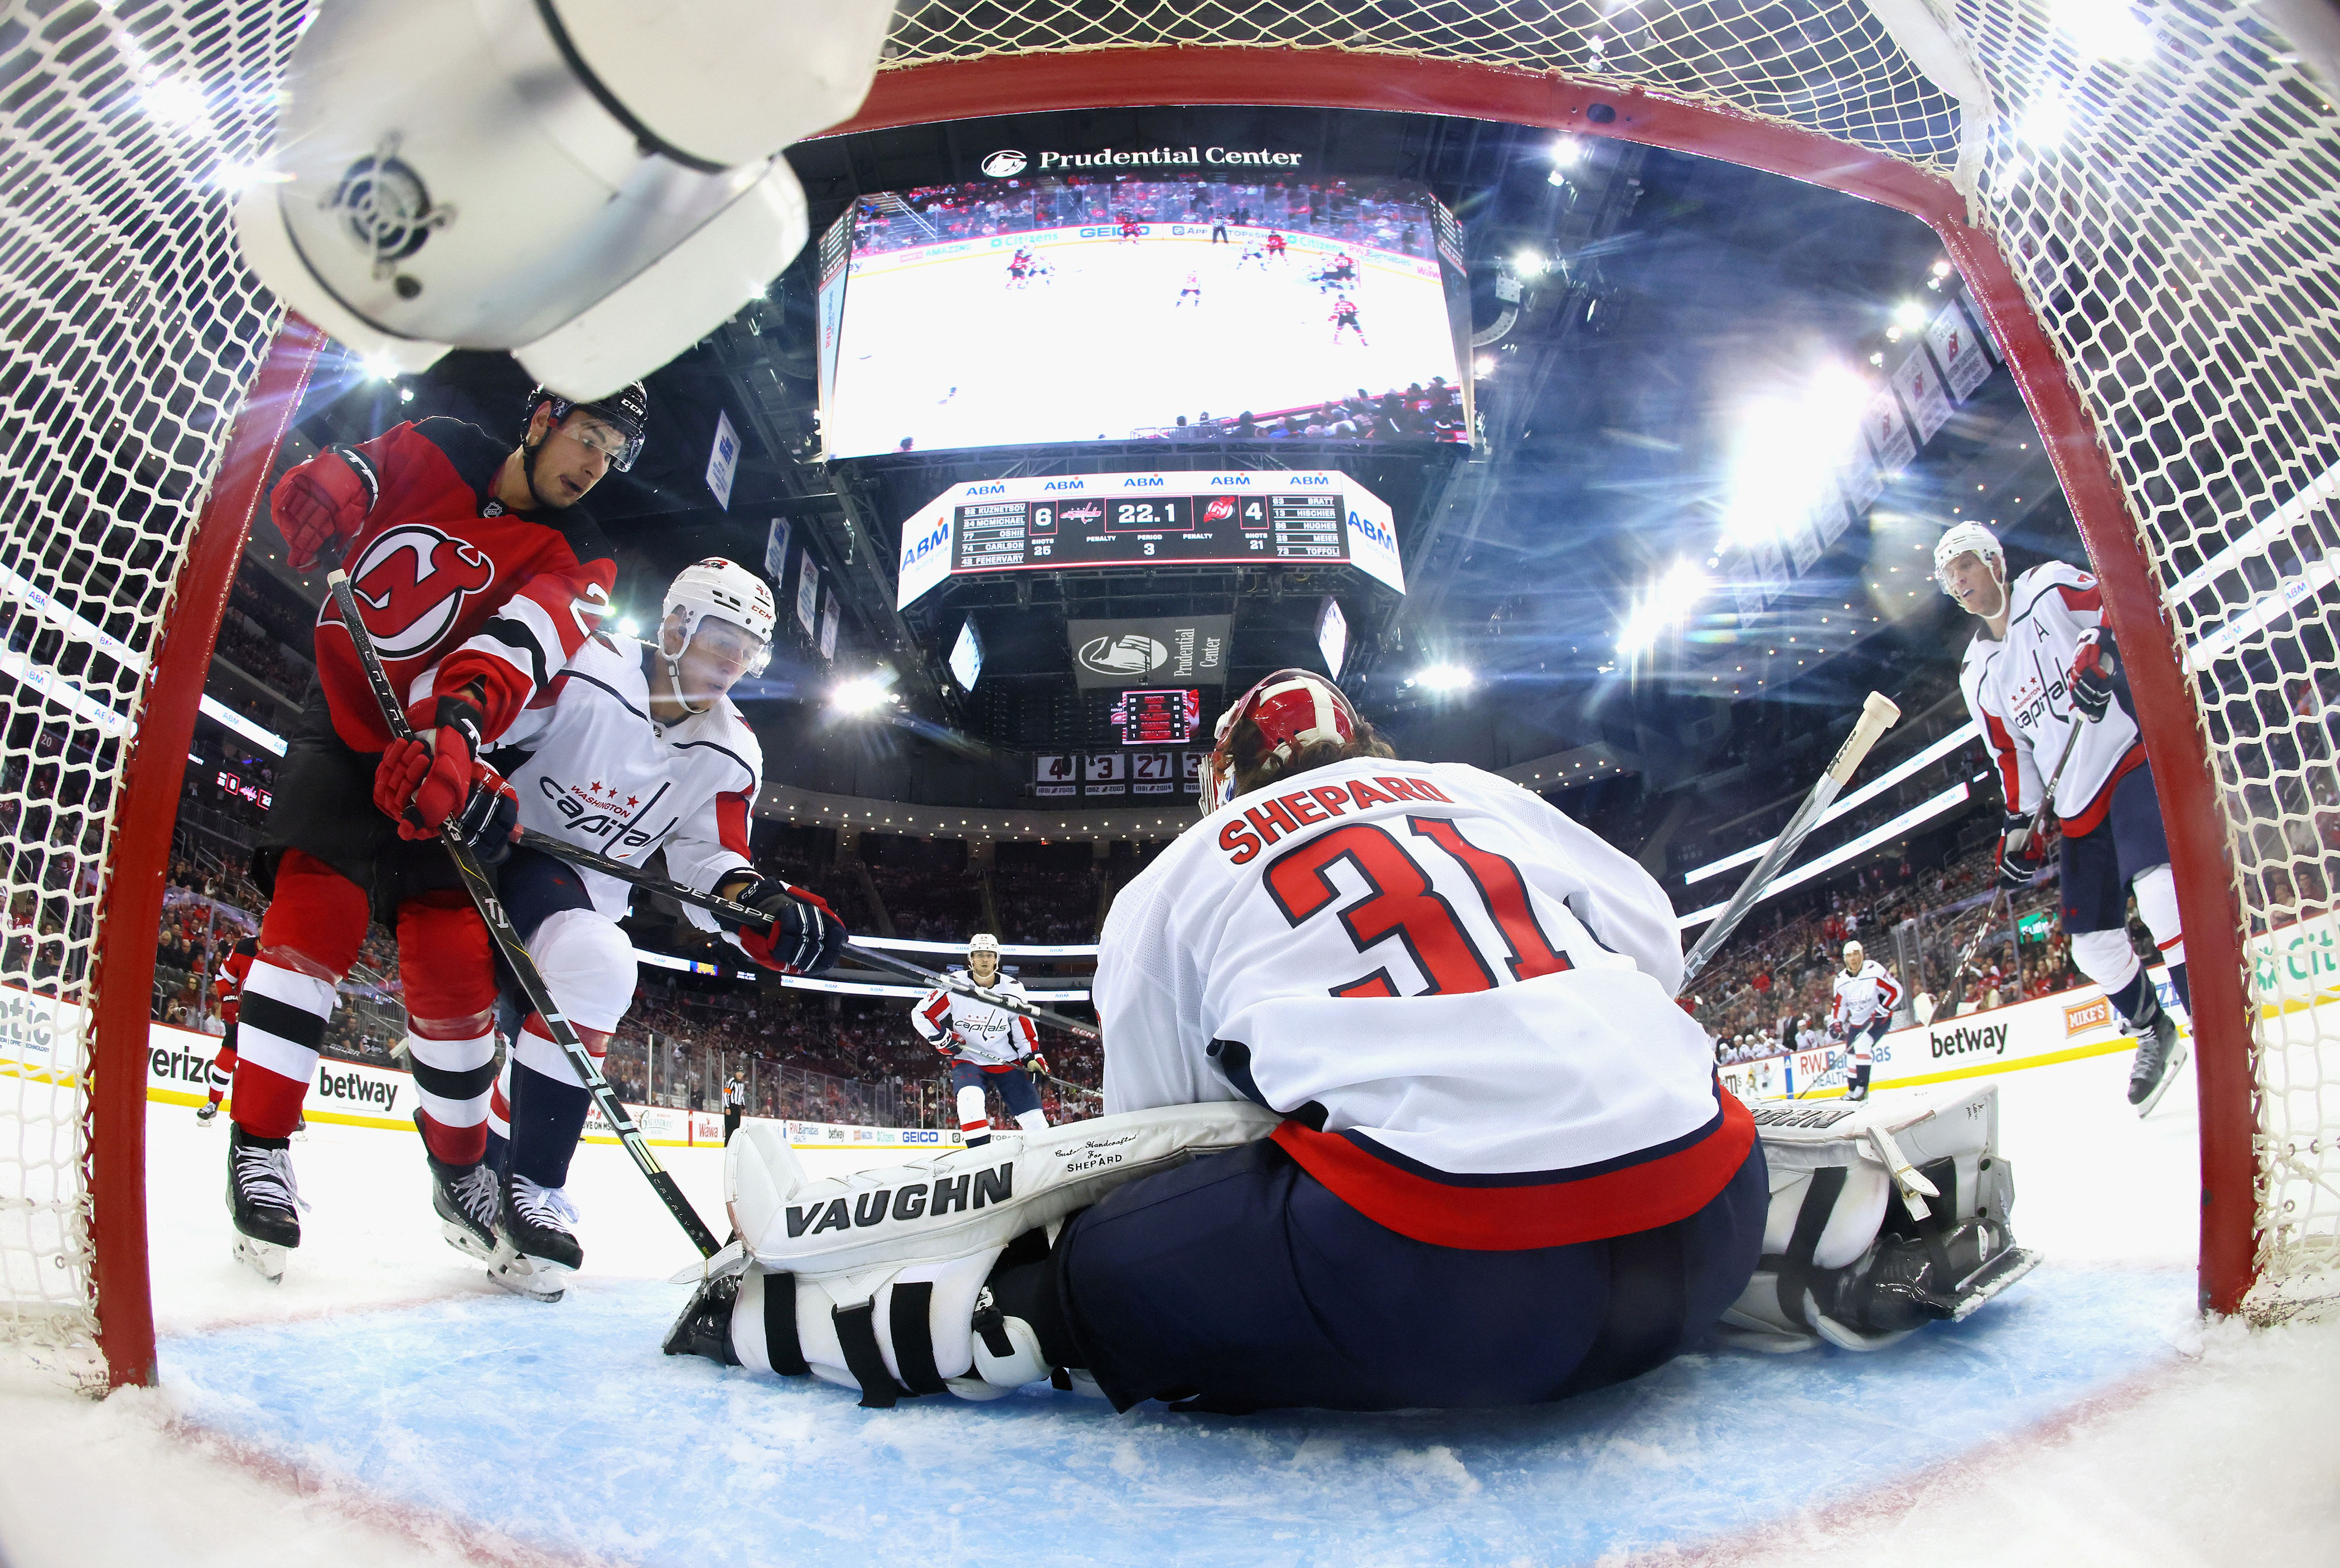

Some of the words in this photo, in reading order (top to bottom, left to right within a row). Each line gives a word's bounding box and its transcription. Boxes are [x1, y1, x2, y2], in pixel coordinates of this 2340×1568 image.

[1040, 147, 1199, 168] Prudential
[1205, 147, 1302, 166] Center
[1005, 231, 1058, 246] Citizens
[1300, 235, 1343, 253] Citizens
[1416, 265, 1441, 279] Waw
[621, 398, 644, 417] CCM
[966, 485, 1004, 496] ABM
[1044, 480, 1084, 491] ABM
[1124, 478, 1164, 486] ABM
[1211, 477, 1250, 485] ABM
[979, 505, 1026, 514] KUZNETSOV
[1036, 508, 1052, 526] 6
[1118, 504, 1175, 524] 22.1
[1245, 502, 1263, 521] 4
[976, 517, 1025, 526] MCMICHAEL
[1348, 511, 1395, 554] ABM
[901, 524, 949, 572] ABM
[985, 542, 1024, 550] CARLSON
[1034, 546, 1051, 555] 25
[1144, 543, 1155, 555] 3
[1250, 540, 1264, 550] 21
[976, 555, 1024, 564] FEHERVARY
[751, 605, 772, 620] CCM
[2033, 617, 2050, 643] A
[1174, 628, 1195, 677] Prudential
[1200, 637, 1220, 667] Center
[362, 650, 412, 738] CATAL
[2013, 686, 2041, 712] WASHINGTON
[223, 712, 240, 725] ABM
[41, 734, 52, 747] 20
[1050, 758, 1062, 780] 4
[1098, 757, 1113, 778] 3
[1138, 754, 1167, 777] 27
[1186, 754, 1201, 776] 3
[230, 778, 236, 790] 6
[571, 785, 631, 818] WASHINGTON
[539, 776, 679, 856] capital
[1218, 776, 1454, 865] SHEPARD
[741, 880, 759, 900] CCM
[673, 885, 775, 923] JETSPE
[1262, 814, 1575, 998] 31
[1716, 893, 1739, 922] SHEPARD
[2288, 930, 2337, 980] Cit
[954, 1008, 1008, 1042] capitals
[2069, 1004, 2106, 1028] MIKE'S
[1071, 1026, 1098, 1039] CCM
[1930, 1023, 2008, 1059] betway
[26, 1042, 50, 1053] ECHNOLOGY
[320, 1066, 398, 1111] betway
[1751, 1109, 1855, 1128] UGHN
[699, 1122, 718, 1138] Wawa
[790, 1122, 819, 1135] RWJBarnabas
[828, 1127, 845, 1143] betway
[902, 1132, 939, 1143] GEICO
[1085, 1134, 1138, 1149] Handcrafted
[1067, 1154, 1123, 1172] SHEPARD
[1087, 1150, 1103, 1159] For
[785, 1162, 1014, 1238] VAUGHN
